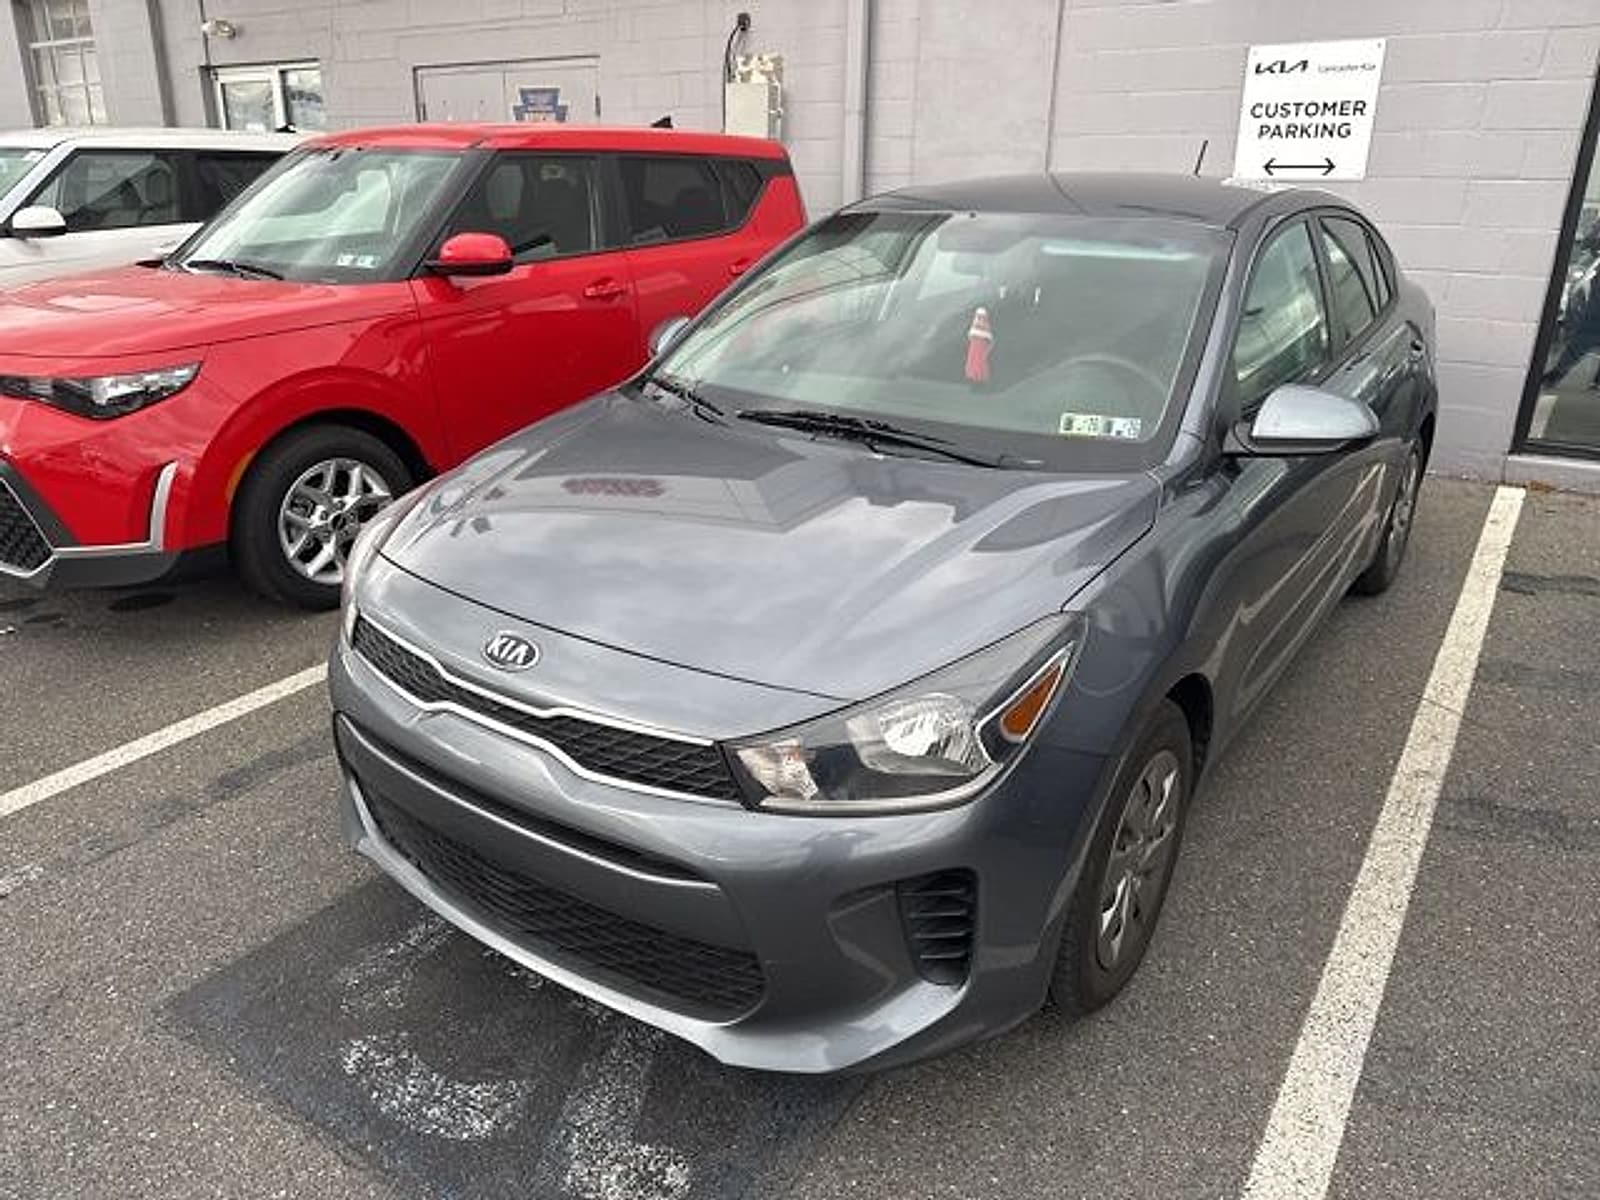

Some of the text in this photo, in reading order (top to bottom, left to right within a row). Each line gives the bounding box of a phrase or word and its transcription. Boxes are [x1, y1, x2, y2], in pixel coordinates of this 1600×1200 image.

[1250, 100, 1367, 118] CUSTOMER
[1258, 122, 1351, 139] PARKING
[486, 637, 529, 664] KIA
